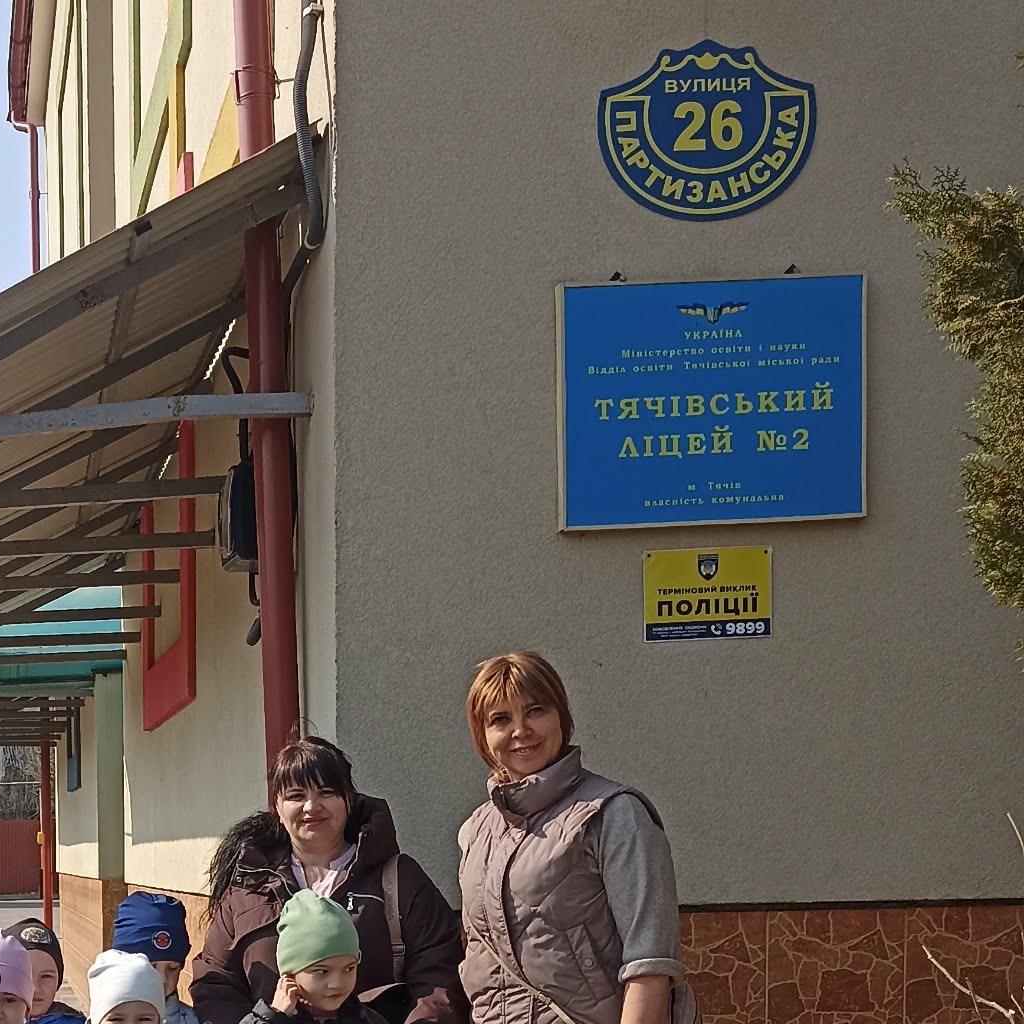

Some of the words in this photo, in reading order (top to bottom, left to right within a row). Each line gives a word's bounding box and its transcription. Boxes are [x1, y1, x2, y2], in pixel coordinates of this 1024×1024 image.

[664, 77, 751, 93] ВУЛИЦЯ
[673, 100, 743, 151] 26
[615, 105, 800, 203] ПАРТИЗАНСЬКА
[684, 329, 743, 340] УКРАЇНА
[621, 347, 705, 359] Міністерство
[711, 345, 752, 354] освіти
[769, 343, 806, 352] науки
[588, 365, 627, 375] Відділ
[632, 363, 673, 373] освіти
[811, 356, 840, 366] ради
[594, 381, 834, 420] ТЯЧІВСЬКИЙ
[618, 424, 734, 459] ЛІЦЕЙ
[707, 481, 741, 491] Тячів
[644, 497, 704, 507] власність
[711, 494, 785, 505] комунальна
[658, 586, 717, 595] ТЕРМІНОВИЙ
[719, 585, 757, 593] ВИКЛИК
[657, 592, 759, 616] ПОЛІЦІЇ
[725, 621, 766, 635] 9899
